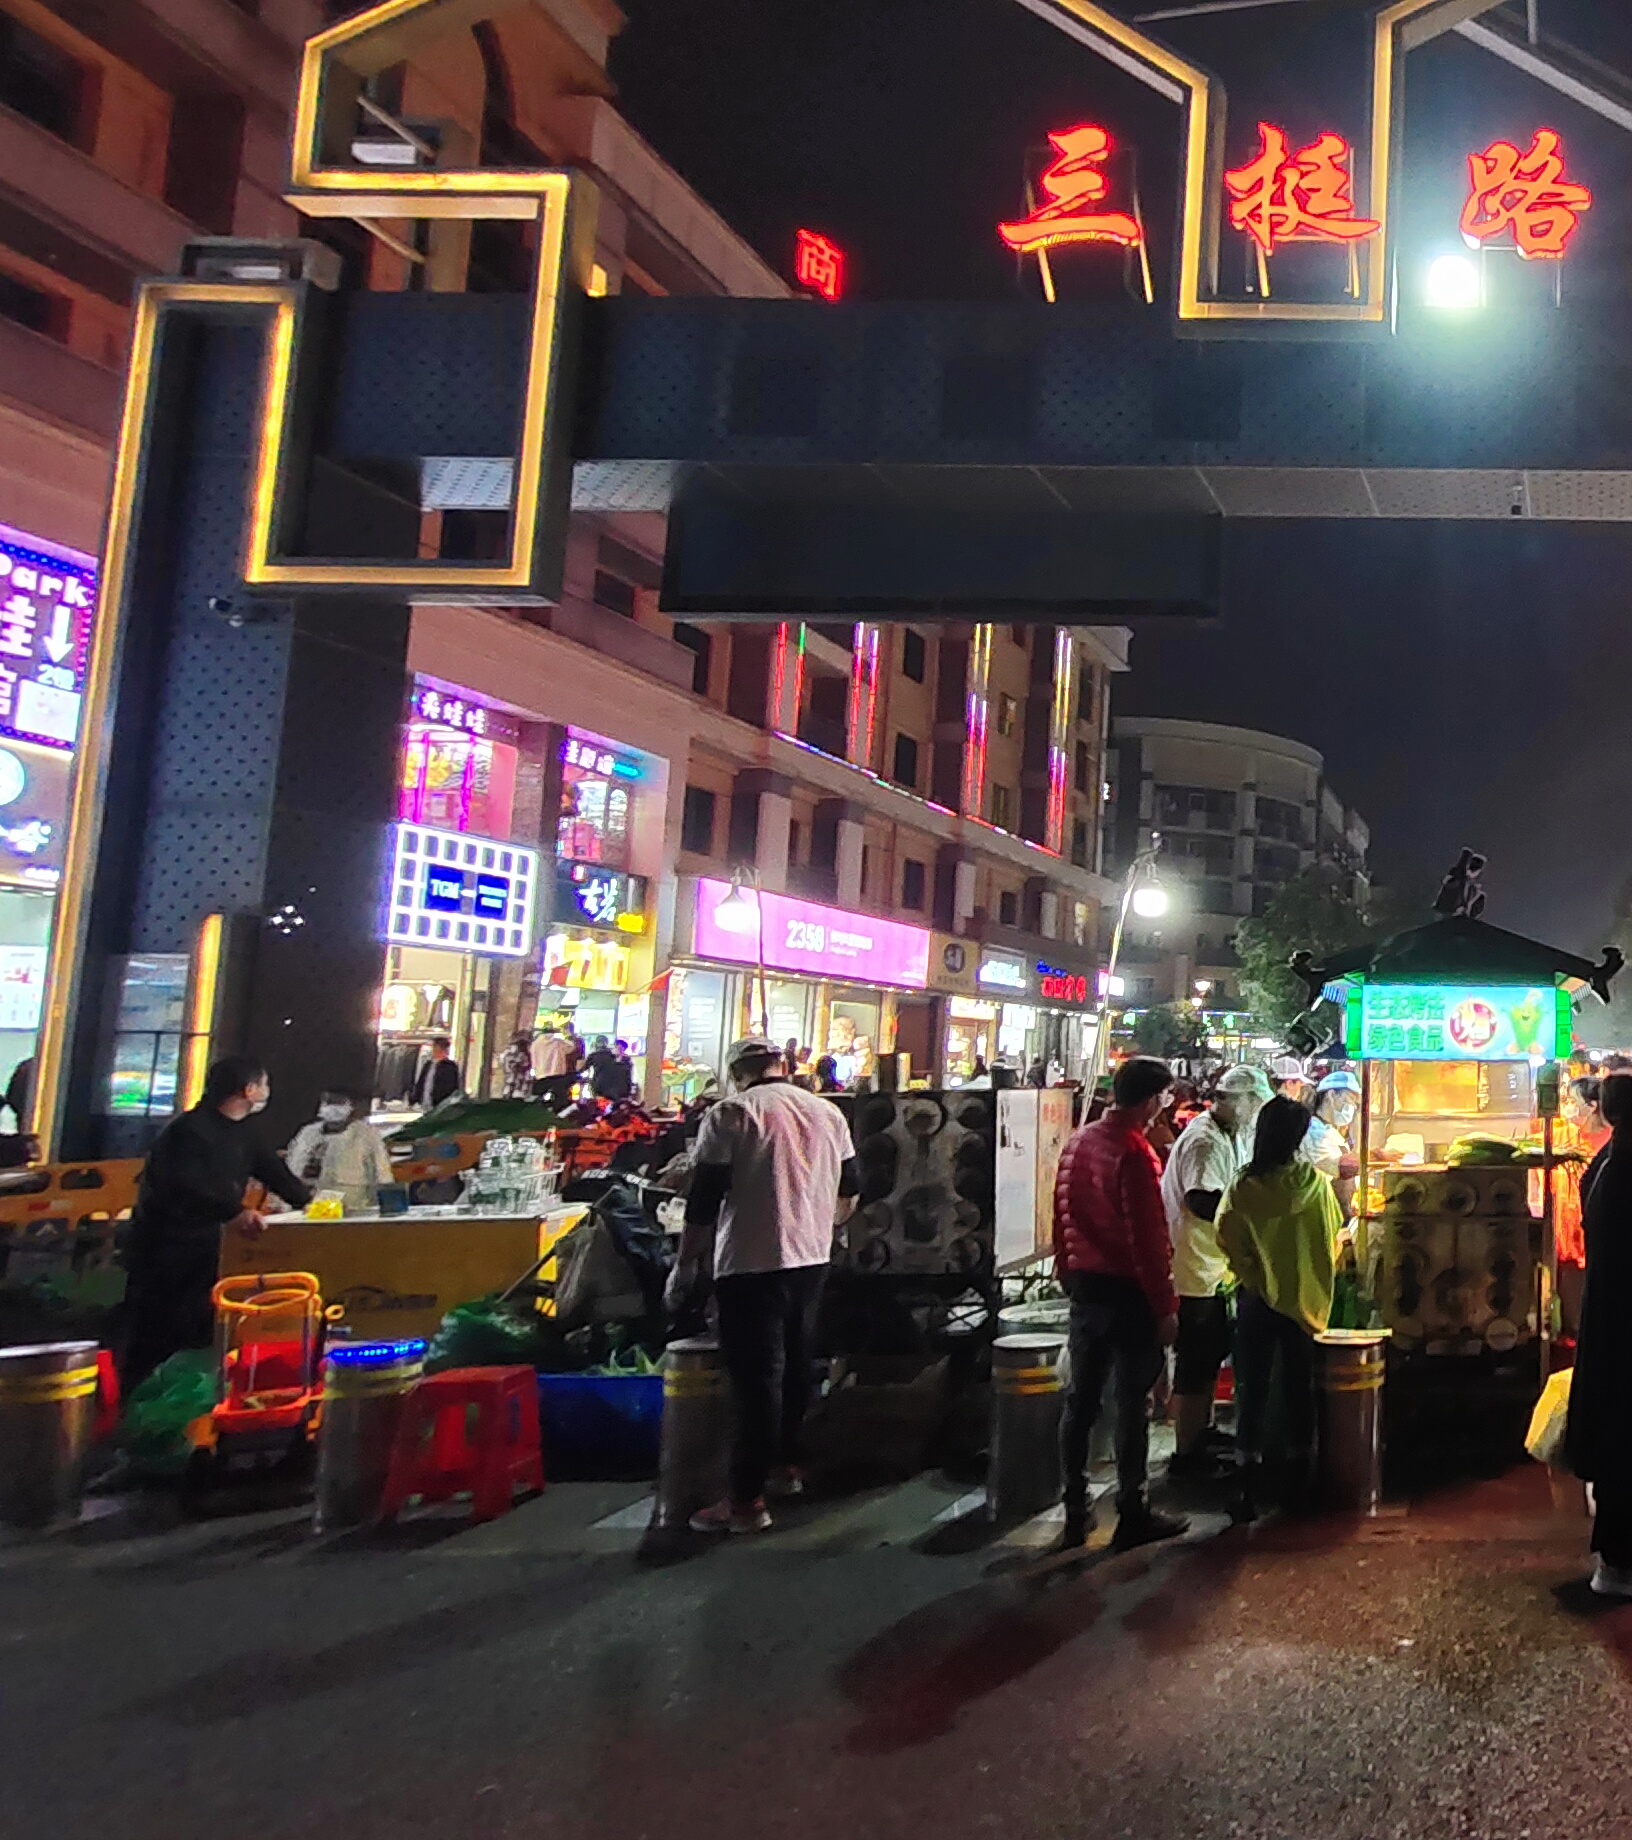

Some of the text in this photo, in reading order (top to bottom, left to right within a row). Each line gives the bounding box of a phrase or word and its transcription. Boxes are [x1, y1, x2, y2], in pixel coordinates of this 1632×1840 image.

[796, 228, 844, 300] 商
[1367, 1023, 1446, 1052] 绿色食品
